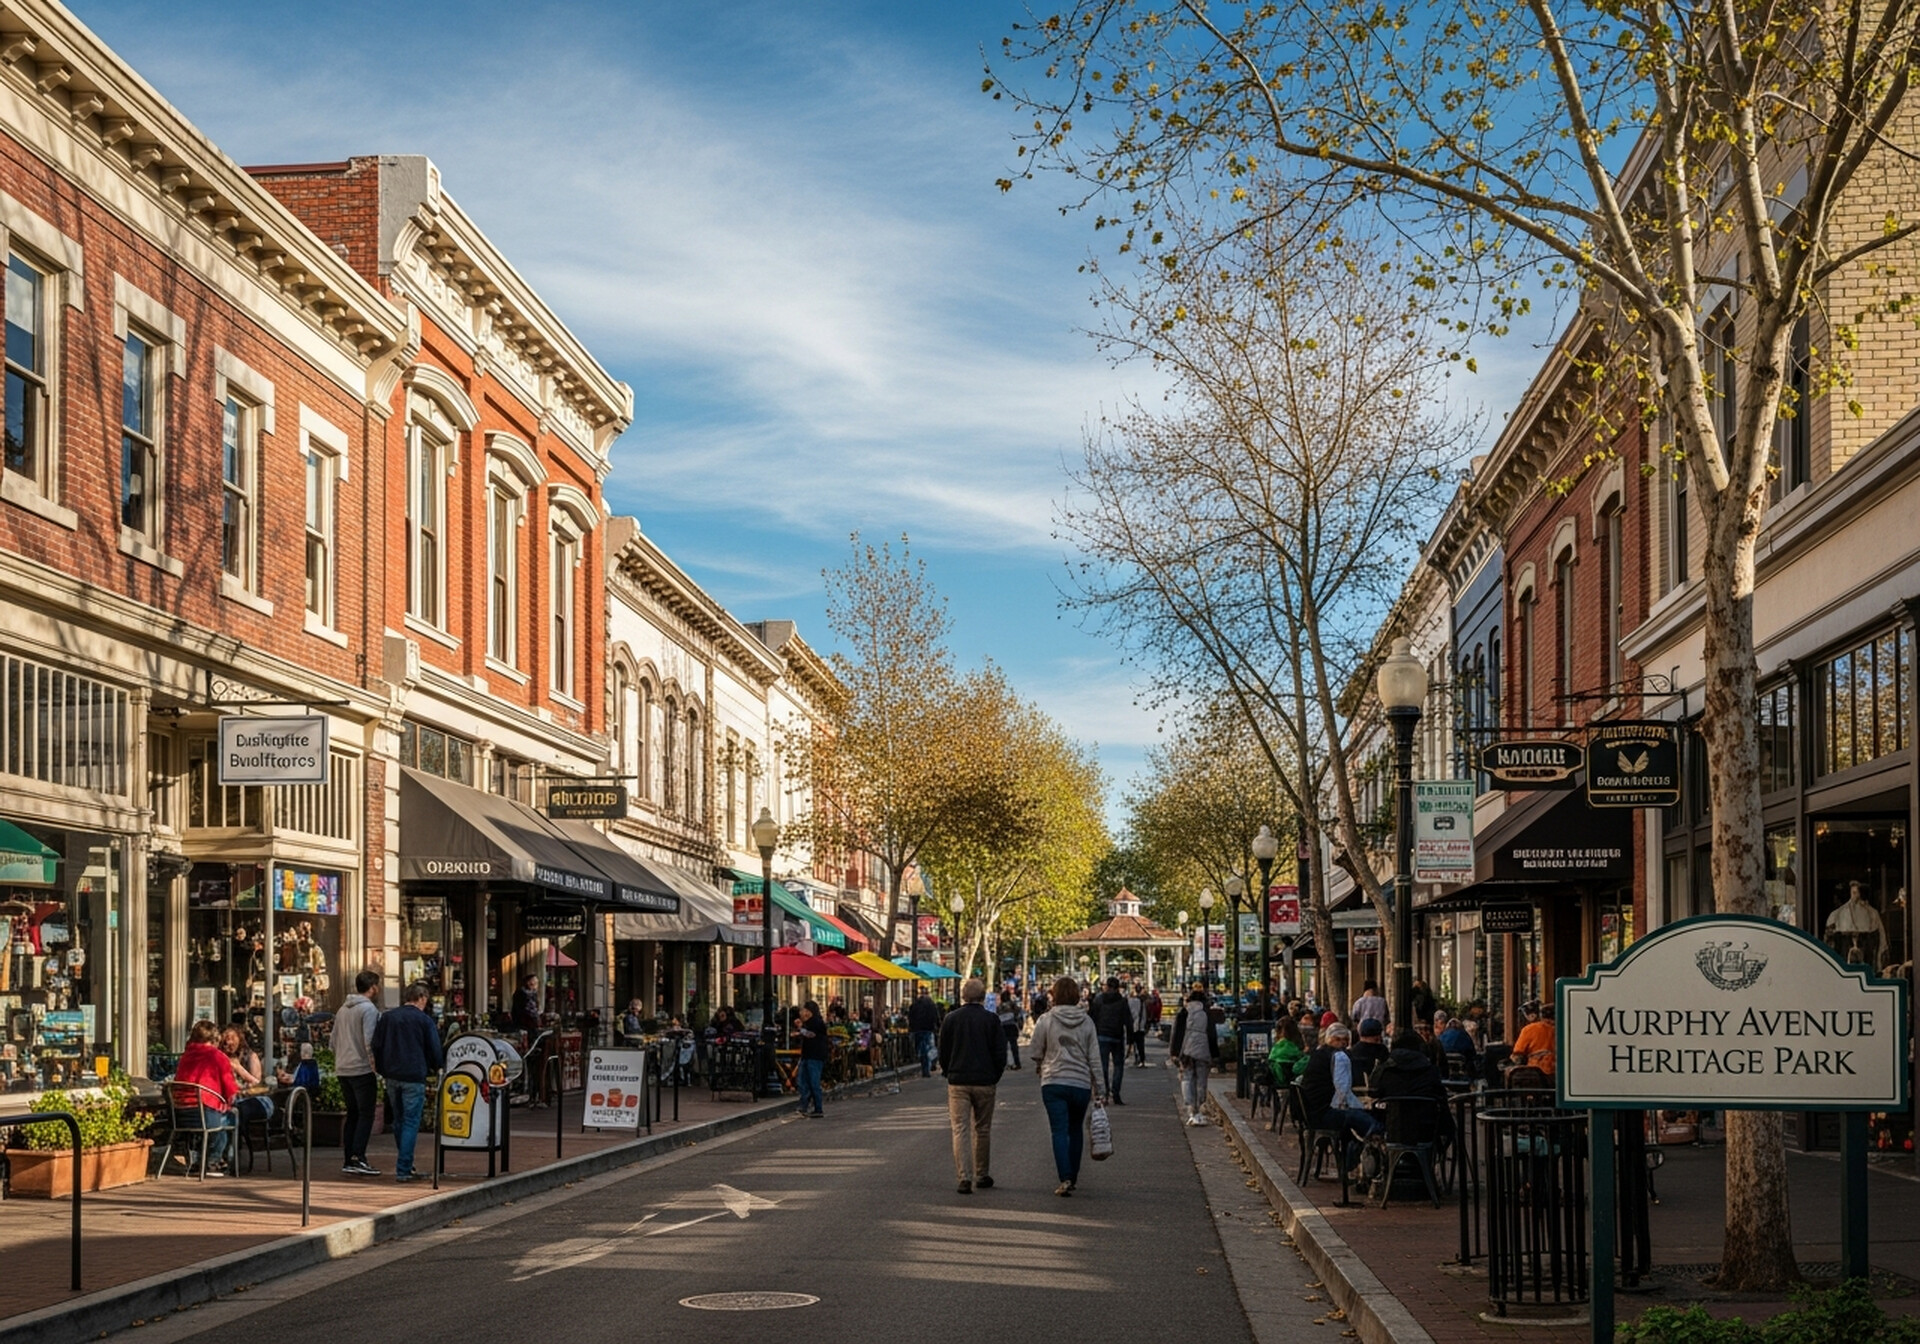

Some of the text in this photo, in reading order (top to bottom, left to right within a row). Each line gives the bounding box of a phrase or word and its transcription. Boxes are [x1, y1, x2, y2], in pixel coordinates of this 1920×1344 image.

[1584, 1006, 1876, 1037] MURPHY AVENUE
[1608, 1044, 1857, 1075] HERITAGE PARK
